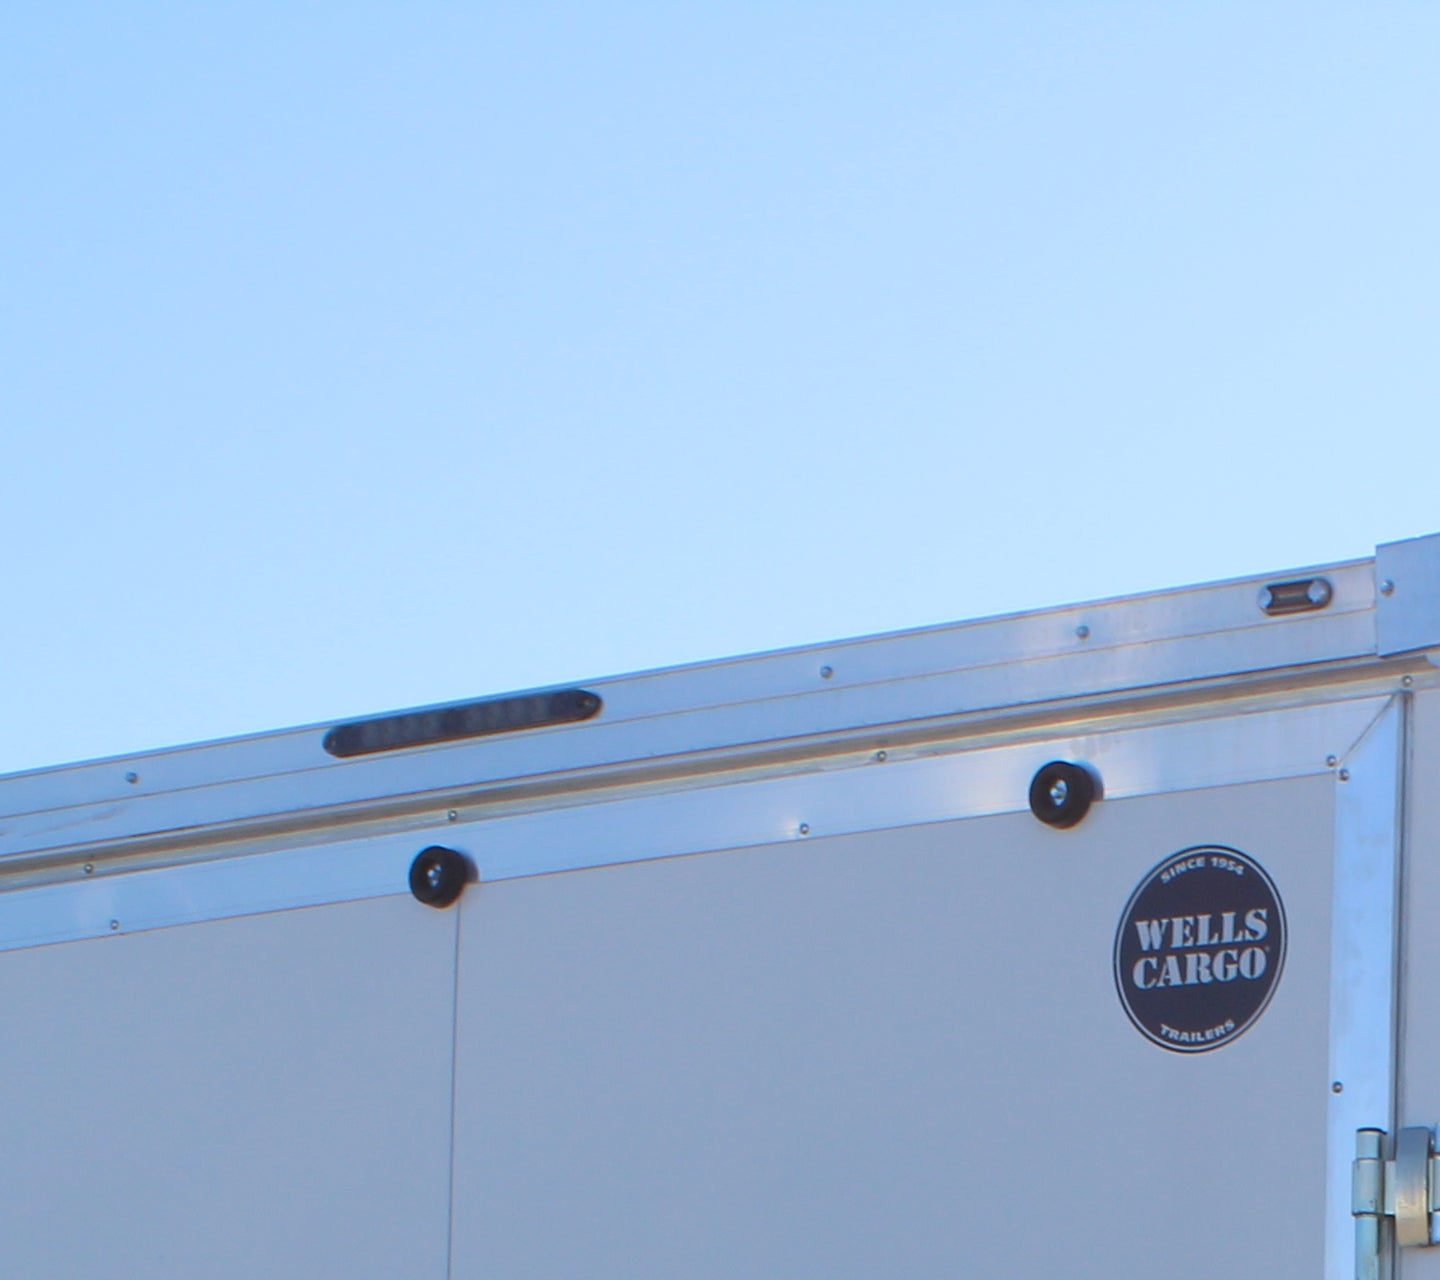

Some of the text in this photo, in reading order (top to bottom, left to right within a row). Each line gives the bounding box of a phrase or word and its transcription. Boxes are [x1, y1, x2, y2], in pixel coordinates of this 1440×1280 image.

[1160, 856, 1245, 884] SINCE 1954
[1135, 908, 1269, 951] WELLS
[1132, 947, 1267, 990] CARGO
[1160, 1019, 1235, 1043] TRAILERS
